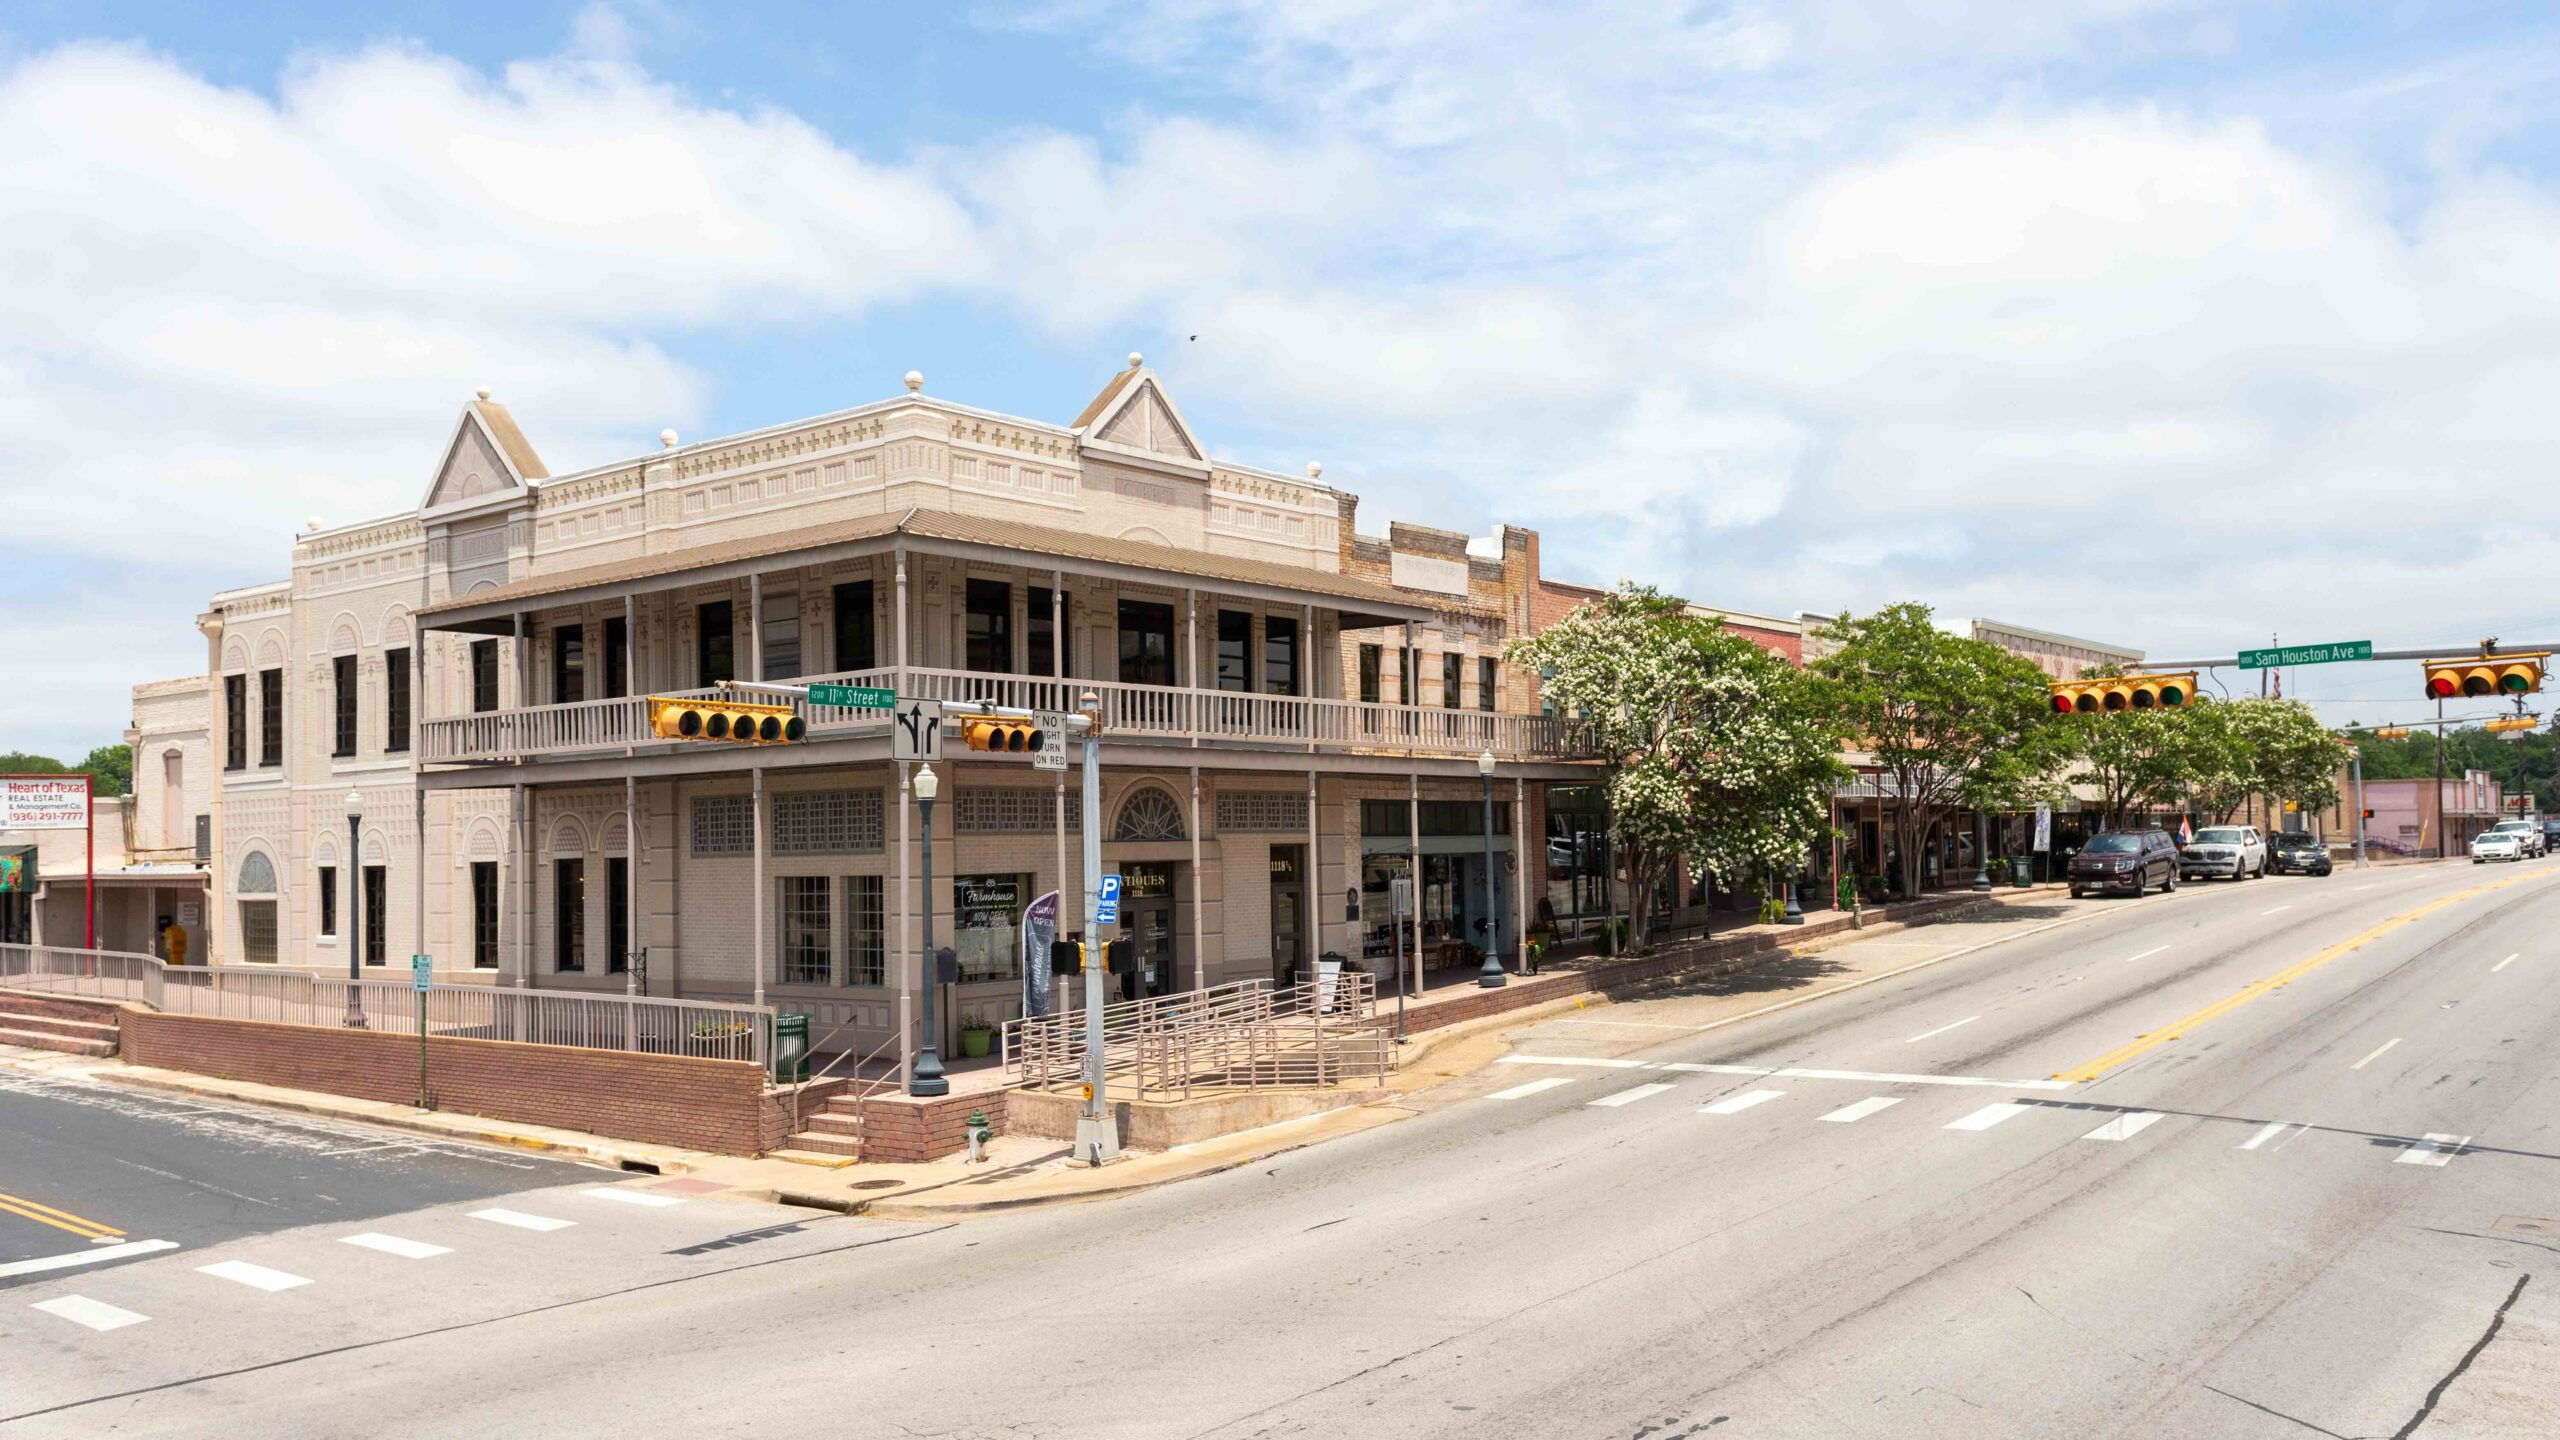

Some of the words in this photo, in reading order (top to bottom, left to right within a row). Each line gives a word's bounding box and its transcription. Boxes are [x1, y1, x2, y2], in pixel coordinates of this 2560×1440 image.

[2255, 652, 2279, 666] Sam
[2281, 648, 2329, 663] Houston
[2332, 646, 2354, 660] Ave
[811, 690, 824, 699] 1200
[846, 689, 879, 705] Street
[1042, 715, 1058, 727] NO
[1043, 730, 1061, 740] IGHT
[1042, 743, 1060, 752] URN
[1035, 754, 1047, 764] ON
[1050, 756, 1065, 765] RED
[8, 783, 40, 793] Heart
[42, 782, 54, 793] of
[54, 783, 86, 793] Texas
[16, 803, 68, 811] Management
[9, 812, 37, 822] (936)
[39, 812, 84, 820] 291-7777
[1101, 878, 1117, 898] P
[966, 890, 1015, 903] Farmhouse
[1035, 905, 1055, 915] NOW
[1033, 916, 1055, 927] OPEN
